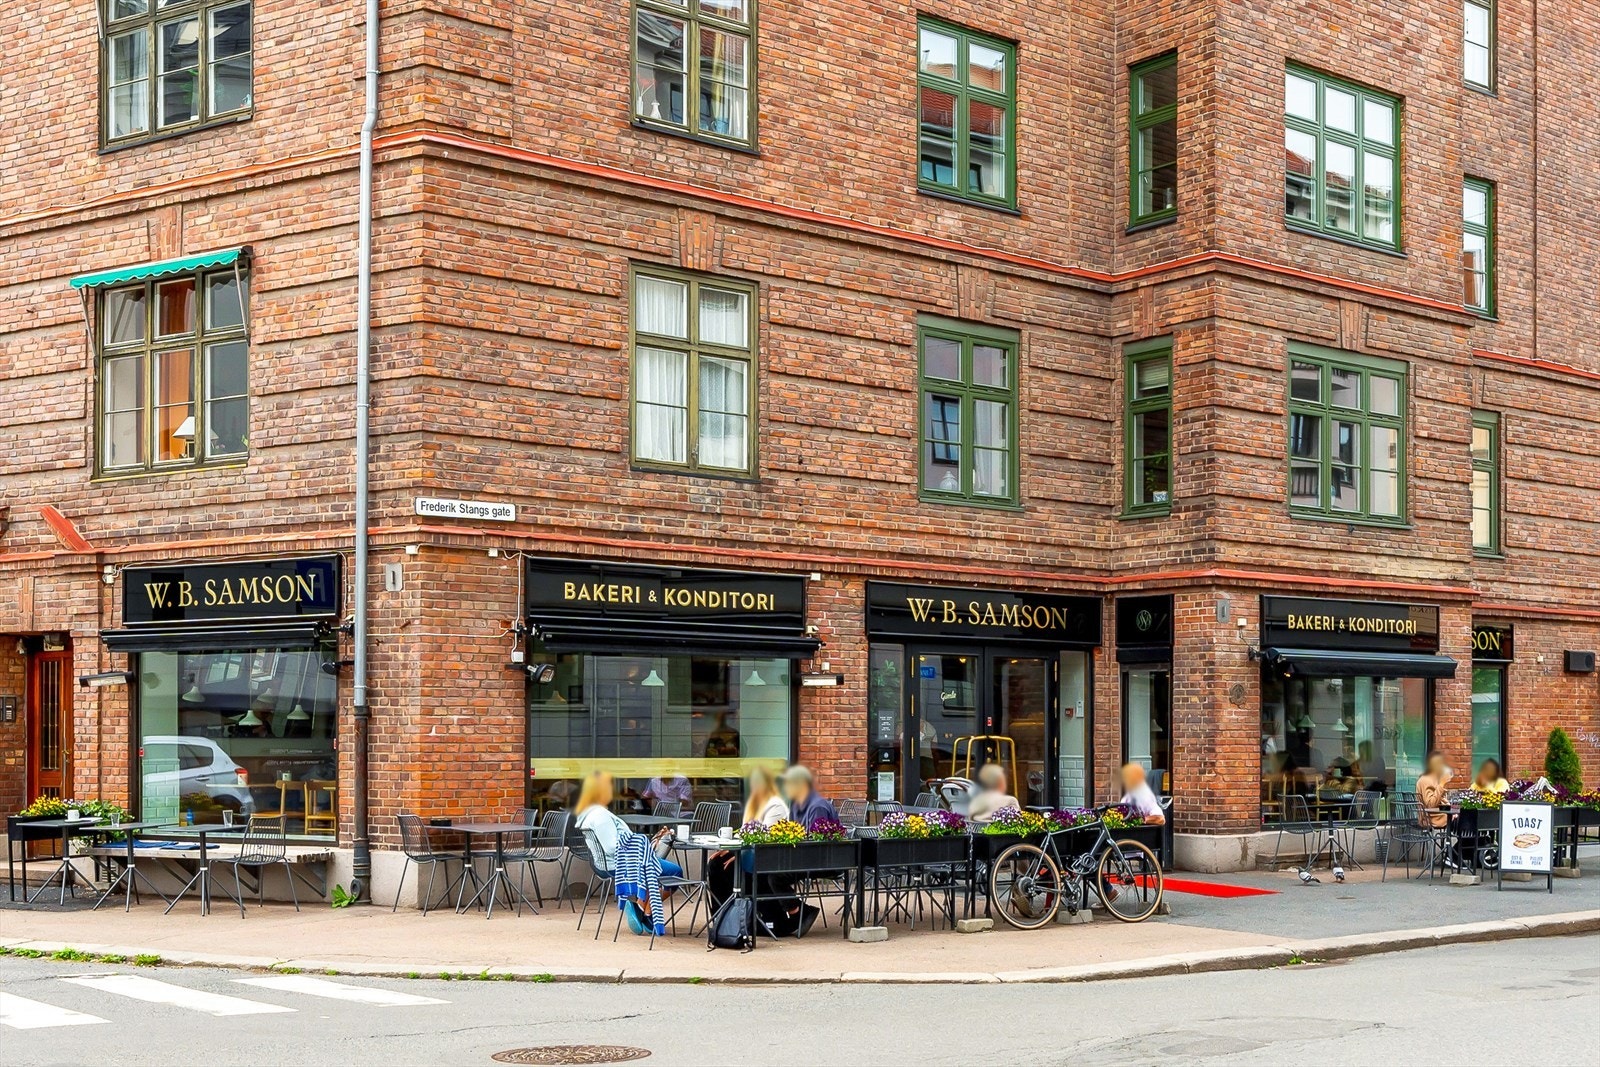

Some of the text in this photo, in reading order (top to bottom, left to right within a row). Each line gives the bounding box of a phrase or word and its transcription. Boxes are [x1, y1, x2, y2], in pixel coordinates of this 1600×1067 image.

[420, 500, 511, 518] Frederik Stangs gate
[144, 574, 316, 608] W. B. SAMSON
[564, 581, 775, 611] BAKERI & KONDITORI
[907, 597, 1067, 629] W. B. SAMSON
[1287, 614, 1417, 634] BAKERI & KONDITORI
[1511, 817, 1543, 829] TOAST
